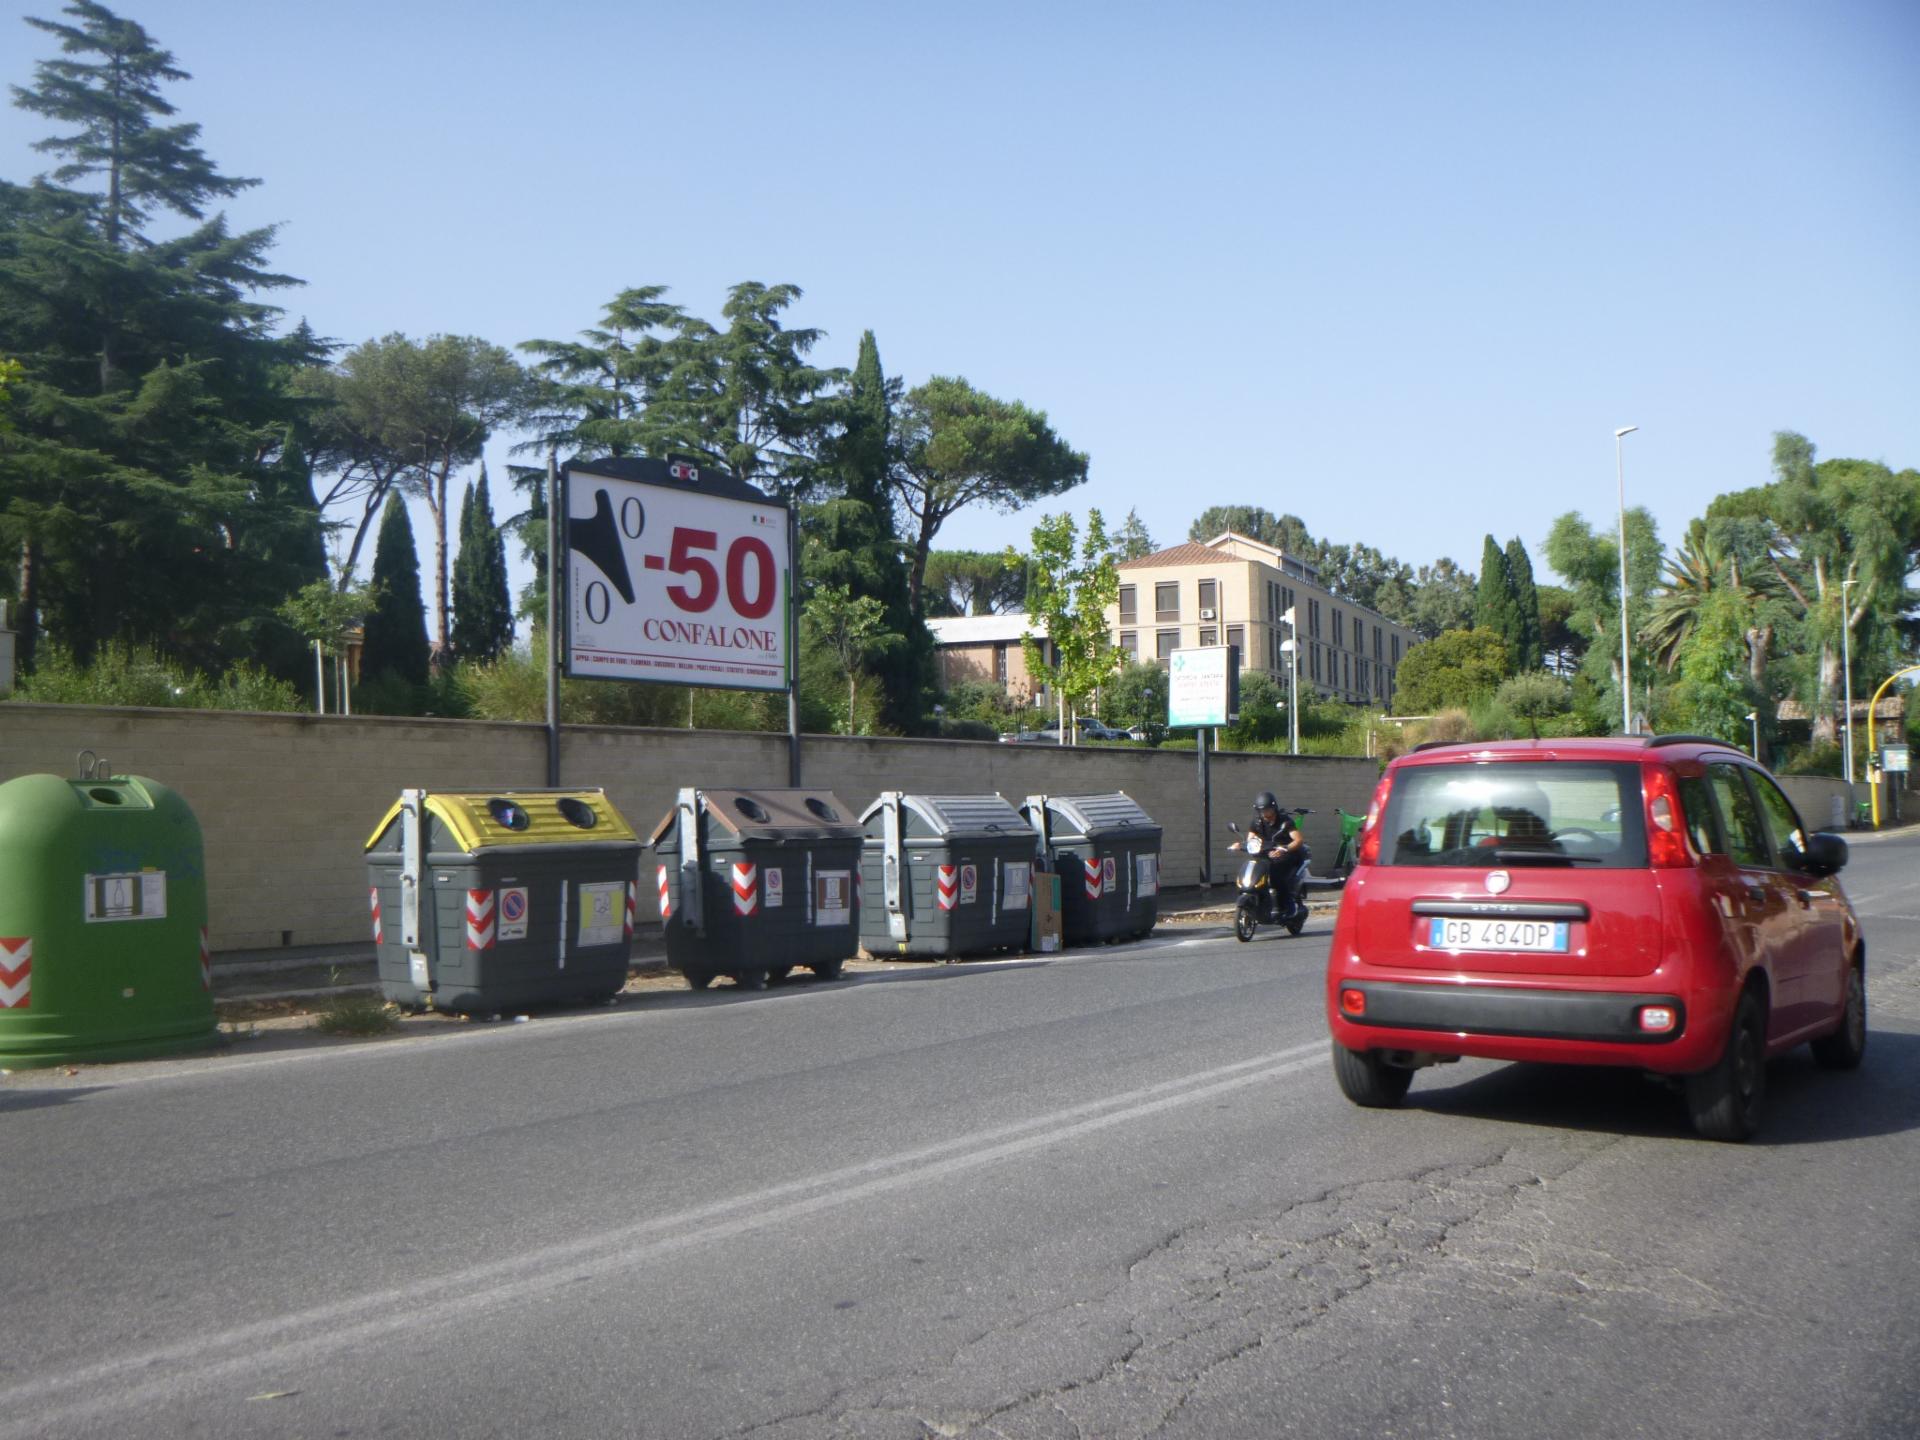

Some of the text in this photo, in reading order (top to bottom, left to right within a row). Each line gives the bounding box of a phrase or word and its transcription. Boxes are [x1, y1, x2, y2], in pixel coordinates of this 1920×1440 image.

[643, 618, 778, 653] CONFALONE
[1446, 921, 1550, 947] GB 484DP
